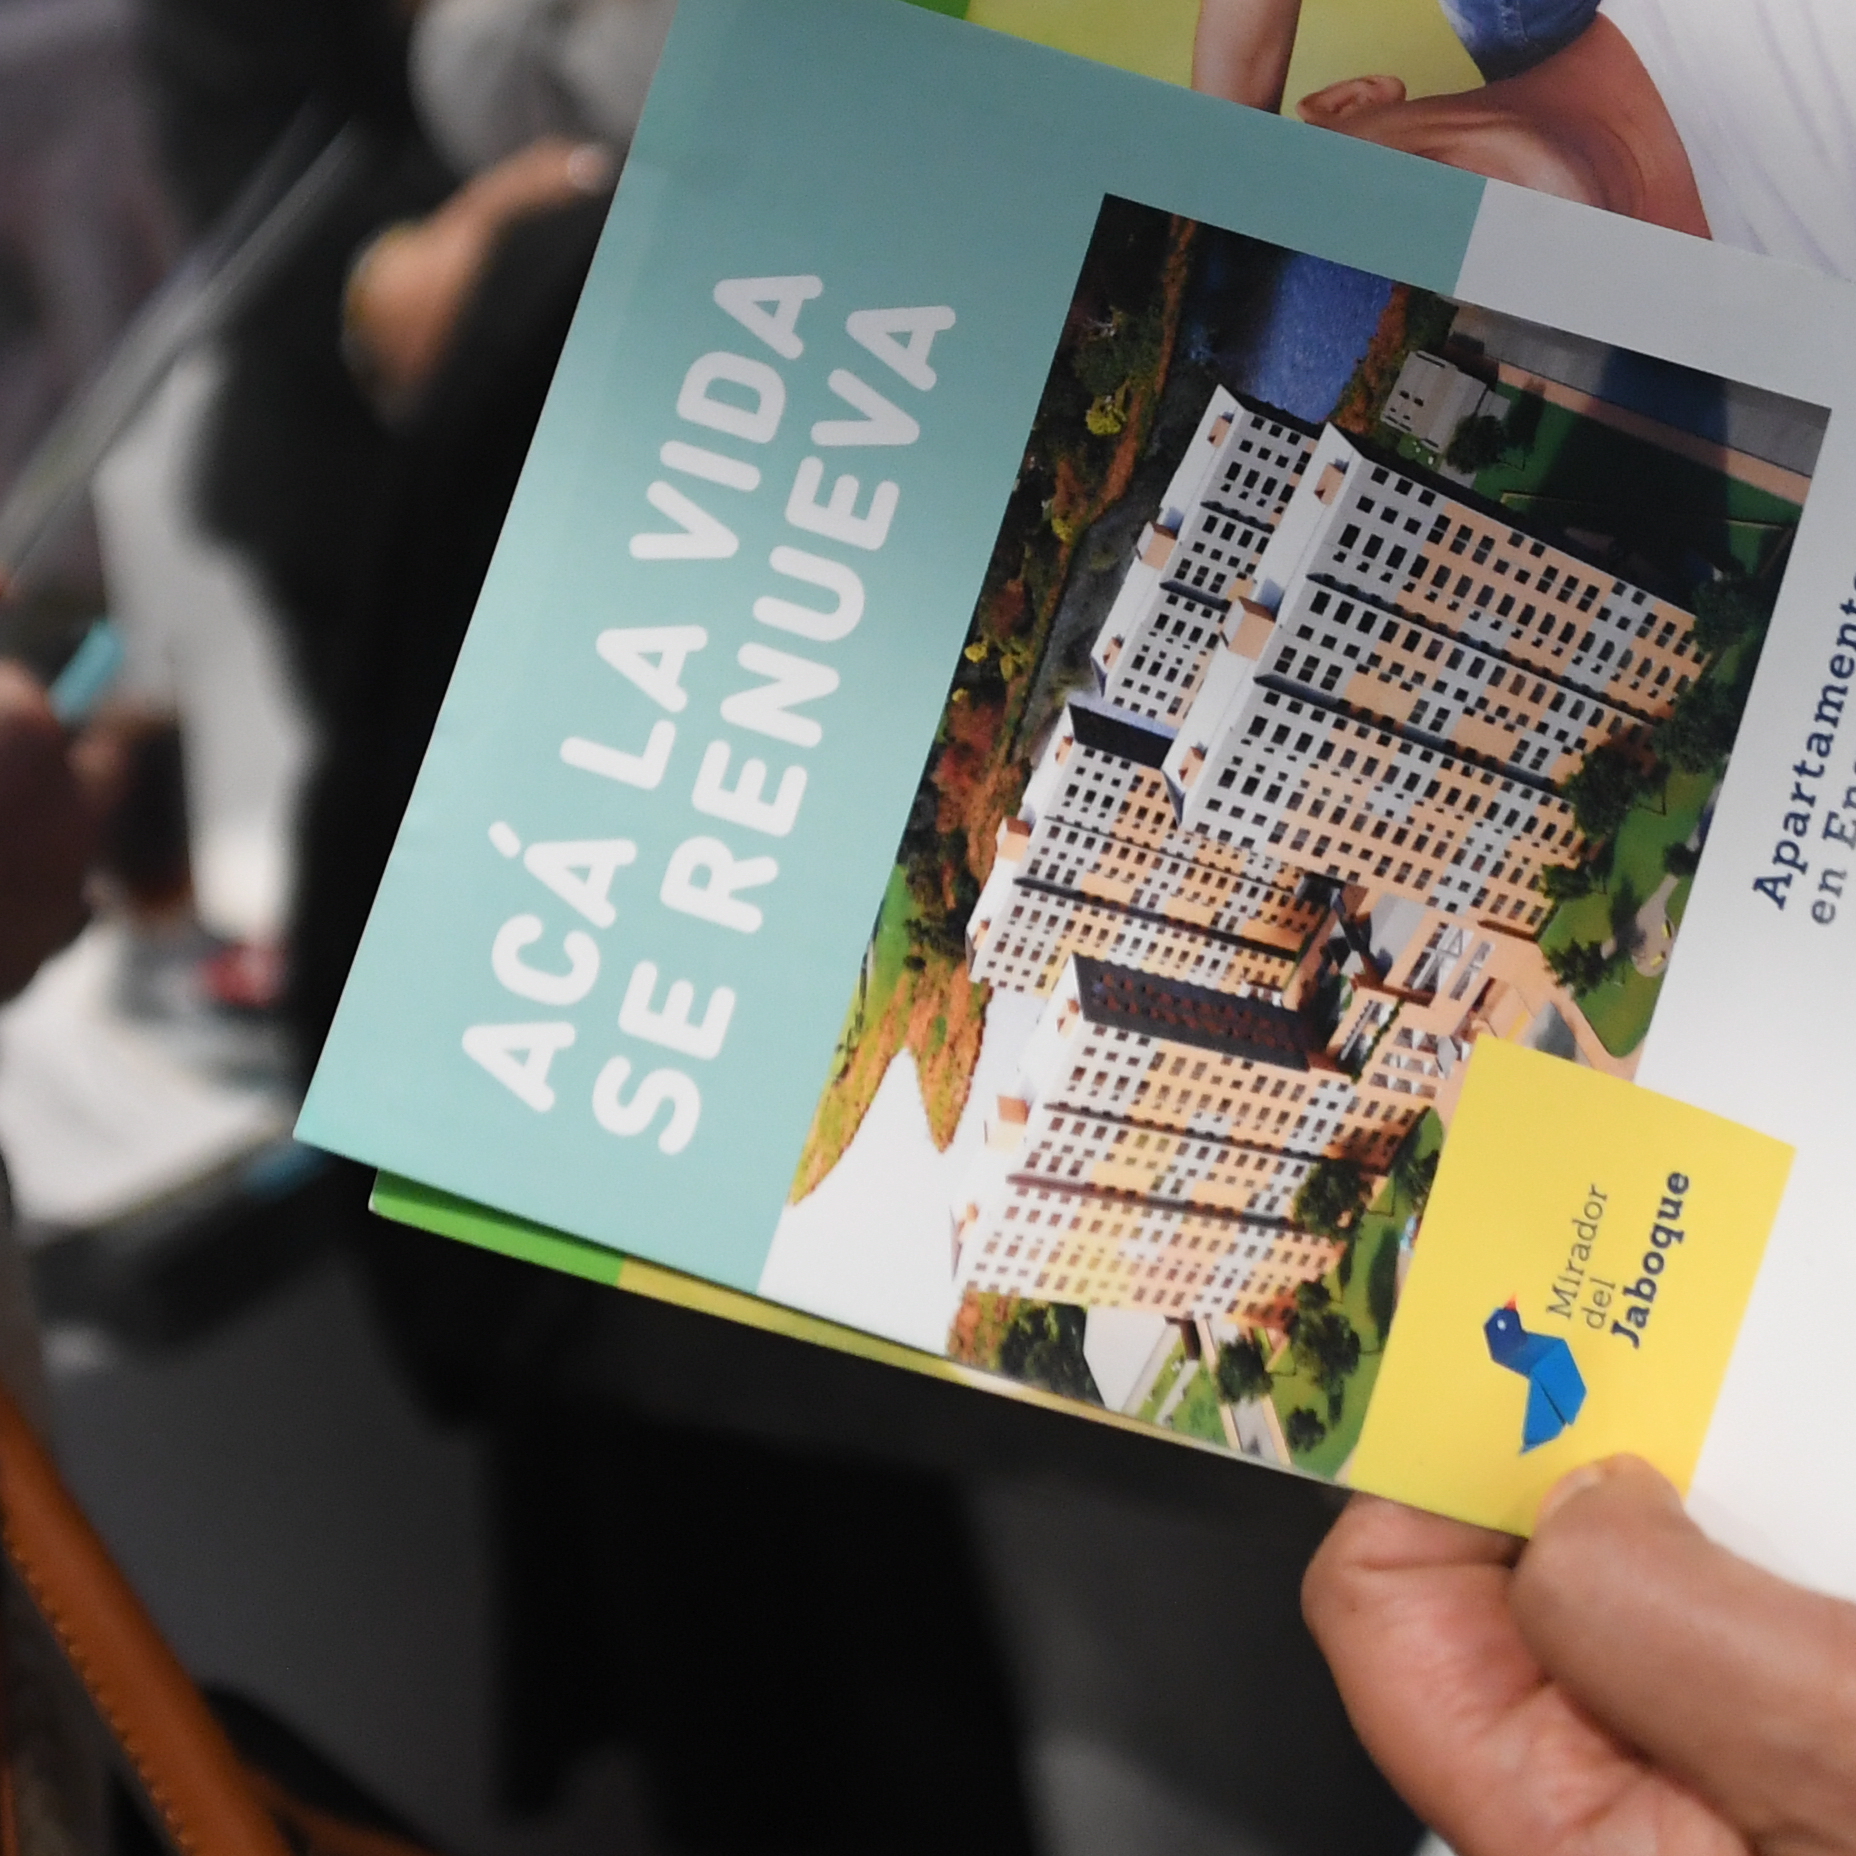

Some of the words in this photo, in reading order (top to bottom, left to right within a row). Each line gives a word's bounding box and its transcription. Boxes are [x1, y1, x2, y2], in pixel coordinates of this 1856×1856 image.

[627, 275, 823, 563] VIDA
[560, 626, 707, 788] LA
[658, 305, 956, 937] RENUEVA
[462, 822, 636, 1111] ACÁ
[1810, 868, 1847, 925] en
[592, 961, 735, 1153] SE
[1545, 1183, 1607, 1319] Mirador
[1580, 1276, 1616, 1329] del
[1610, 1171, 1689, 1348] Jaboque
